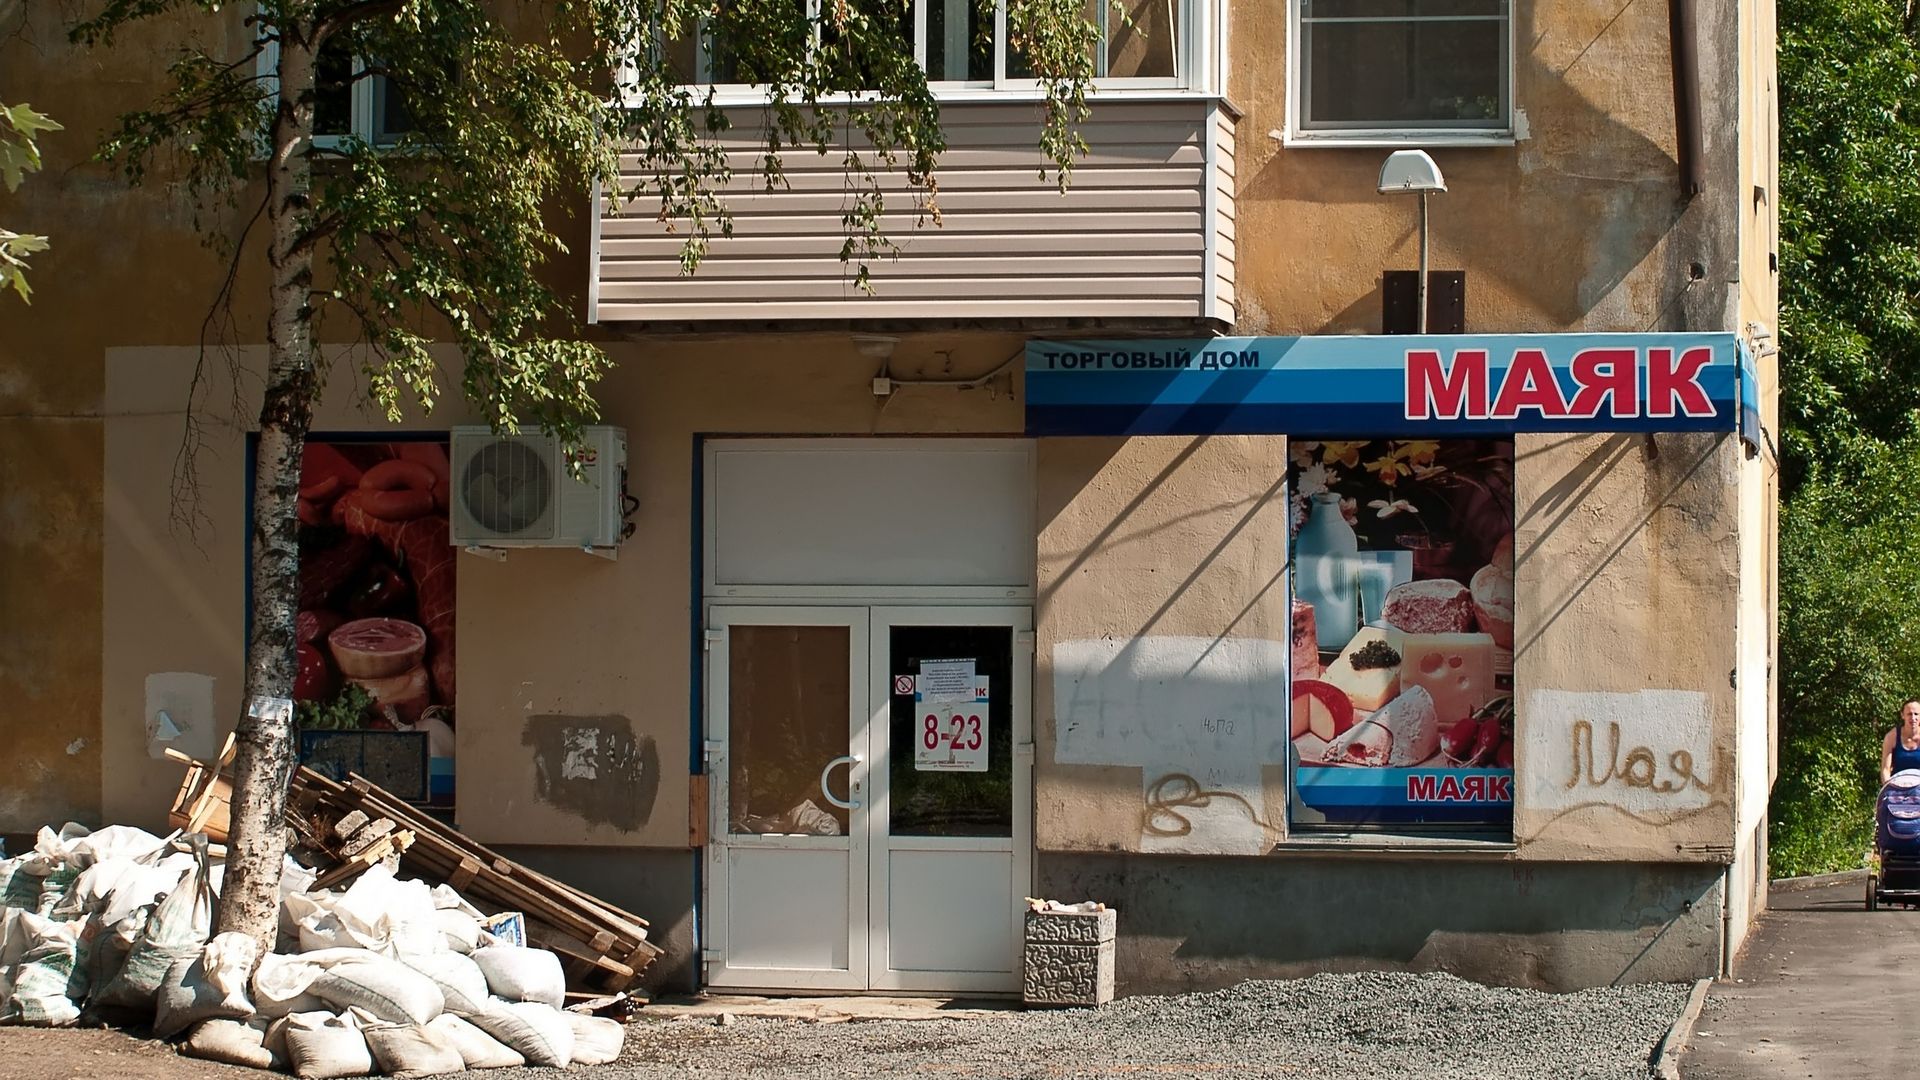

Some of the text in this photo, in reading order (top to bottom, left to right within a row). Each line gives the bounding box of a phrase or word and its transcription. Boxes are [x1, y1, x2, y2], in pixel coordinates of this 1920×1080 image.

[1043, 348, 1259, 371] ТОРГОВЫЙ ДОМ
[1404, 346, 1717, 419] МАЯК
[924, 714, 982, 750] 8-23
[1407, 774, 1512, 802] МАЯК
